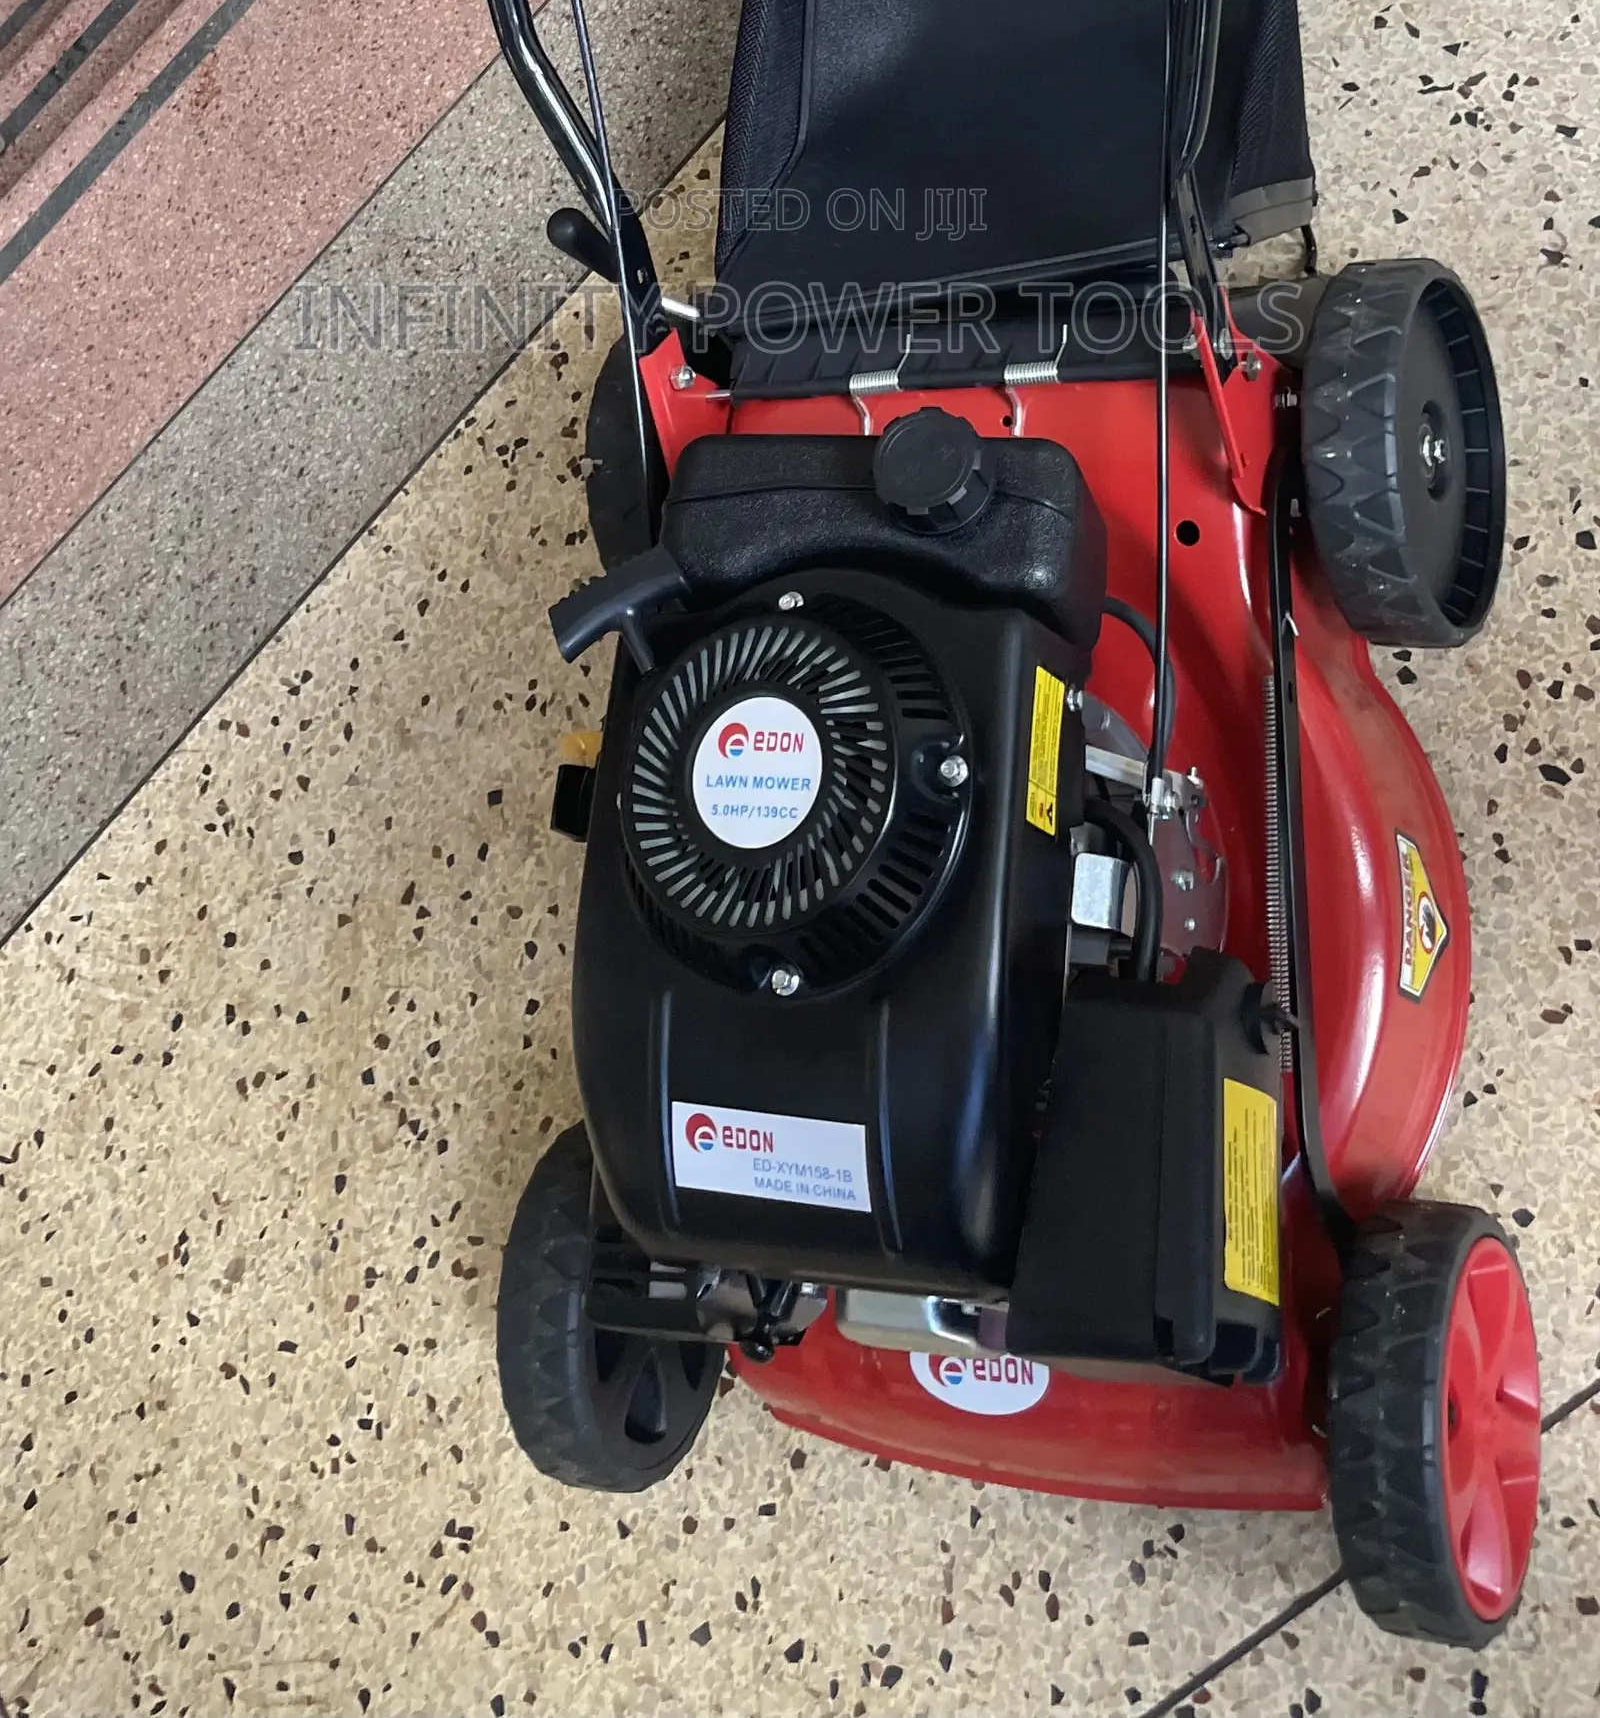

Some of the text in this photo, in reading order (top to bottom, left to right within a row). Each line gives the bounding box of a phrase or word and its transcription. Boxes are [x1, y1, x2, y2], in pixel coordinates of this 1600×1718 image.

[706, 775, 812, 791] LAWN MOWER
[711, 804, 798, 819] 5.0HP/139CC
[1400, 851, 1412, 965] DANGER
[753, 1176, 857, 1201] MADE IN CHINA
